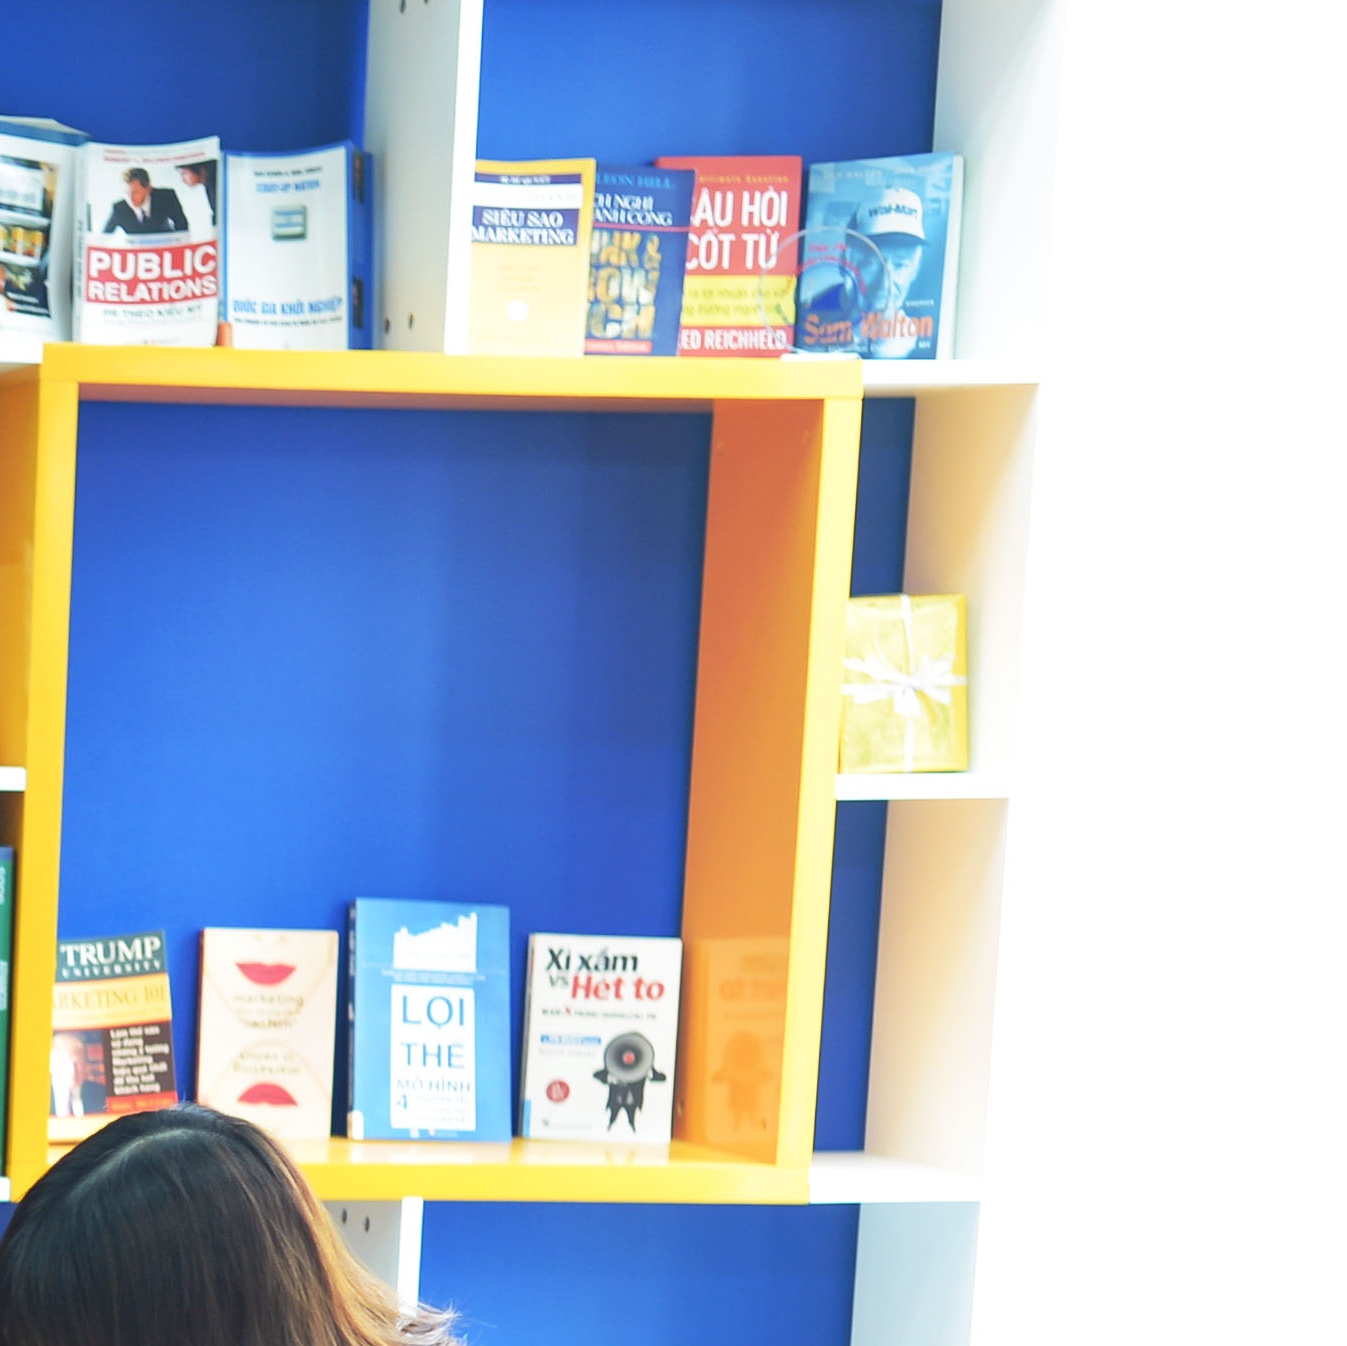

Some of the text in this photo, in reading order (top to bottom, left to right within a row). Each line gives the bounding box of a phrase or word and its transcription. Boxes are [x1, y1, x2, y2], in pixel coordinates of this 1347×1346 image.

[527, 210, 565, 229] SAO
[471, 225, 575, 246] MARKETING
[89, 245, 218, 281] PUBLIC
[88, 276, 218, 303] RELATIONS
[706, 330, 788, 350] REICHHELD
[804, 312, 933, 345] Sam Walton
[60, 935, 162, 967] TRUMP
[61, 960, 162, 979] UNIVERSITY
[635, 977, 666, 1000] to
